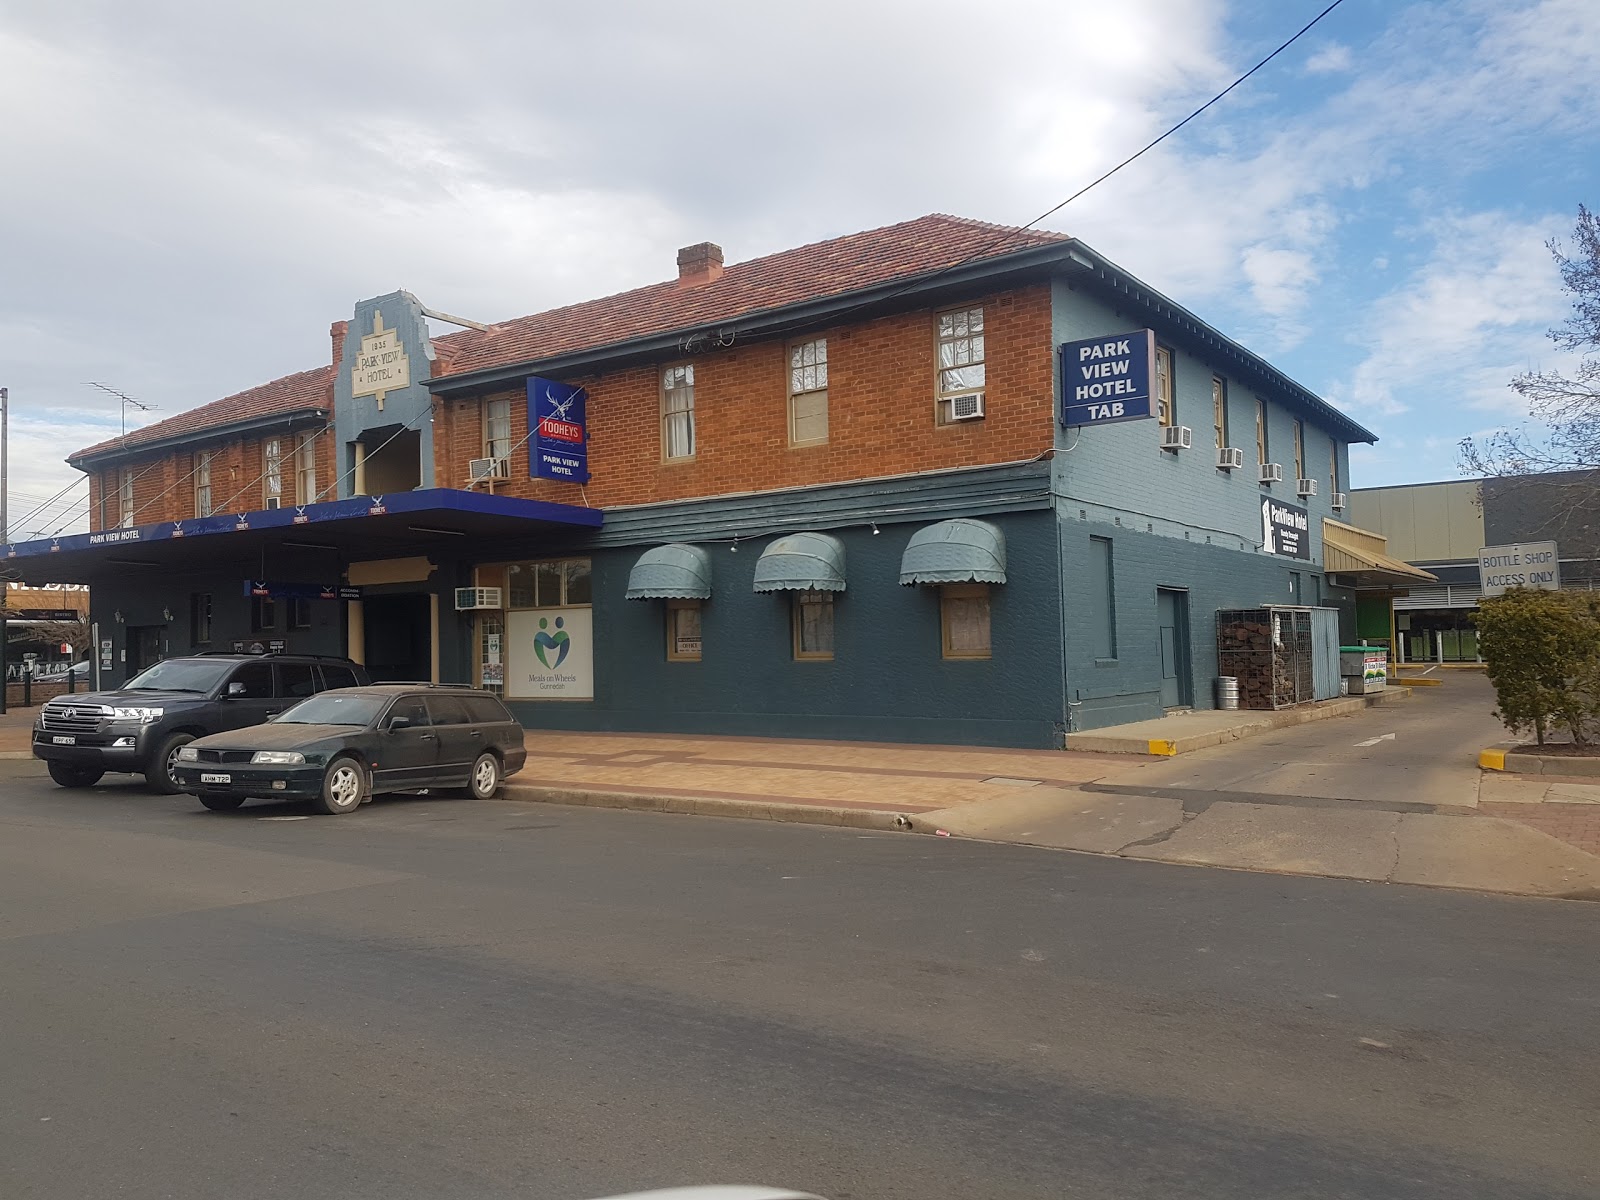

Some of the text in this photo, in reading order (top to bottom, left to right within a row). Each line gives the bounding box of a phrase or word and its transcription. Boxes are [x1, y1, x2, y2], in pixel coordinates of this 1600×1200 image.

[1080, 340, 1130, 361] PARK
[361, 350, 400, 371] PARK VIEW
[367, 368, 393, 383] HOTEL
[1081, 360, 1130, 380] VIEW
[1076, 379, 1137, 400] HOTEL
[1088, 403, 1125, 420] TAB
[544, 421, 579, 438] TOOHEYS
[543, 455, 580, 467] PARK VIEW
[551, 465, 573, 476] HOTEL
[90, 530, 140, 544] PARK VIEW HOTEL
[1483, 552, 1553, 568] BOTTLE SHOP
[1486, 571, 1555, 587] ACCESS ONLY
[528, 673, 577, 683] Meals on Wheels
[540, 682, 566, 690] Gunnedah
